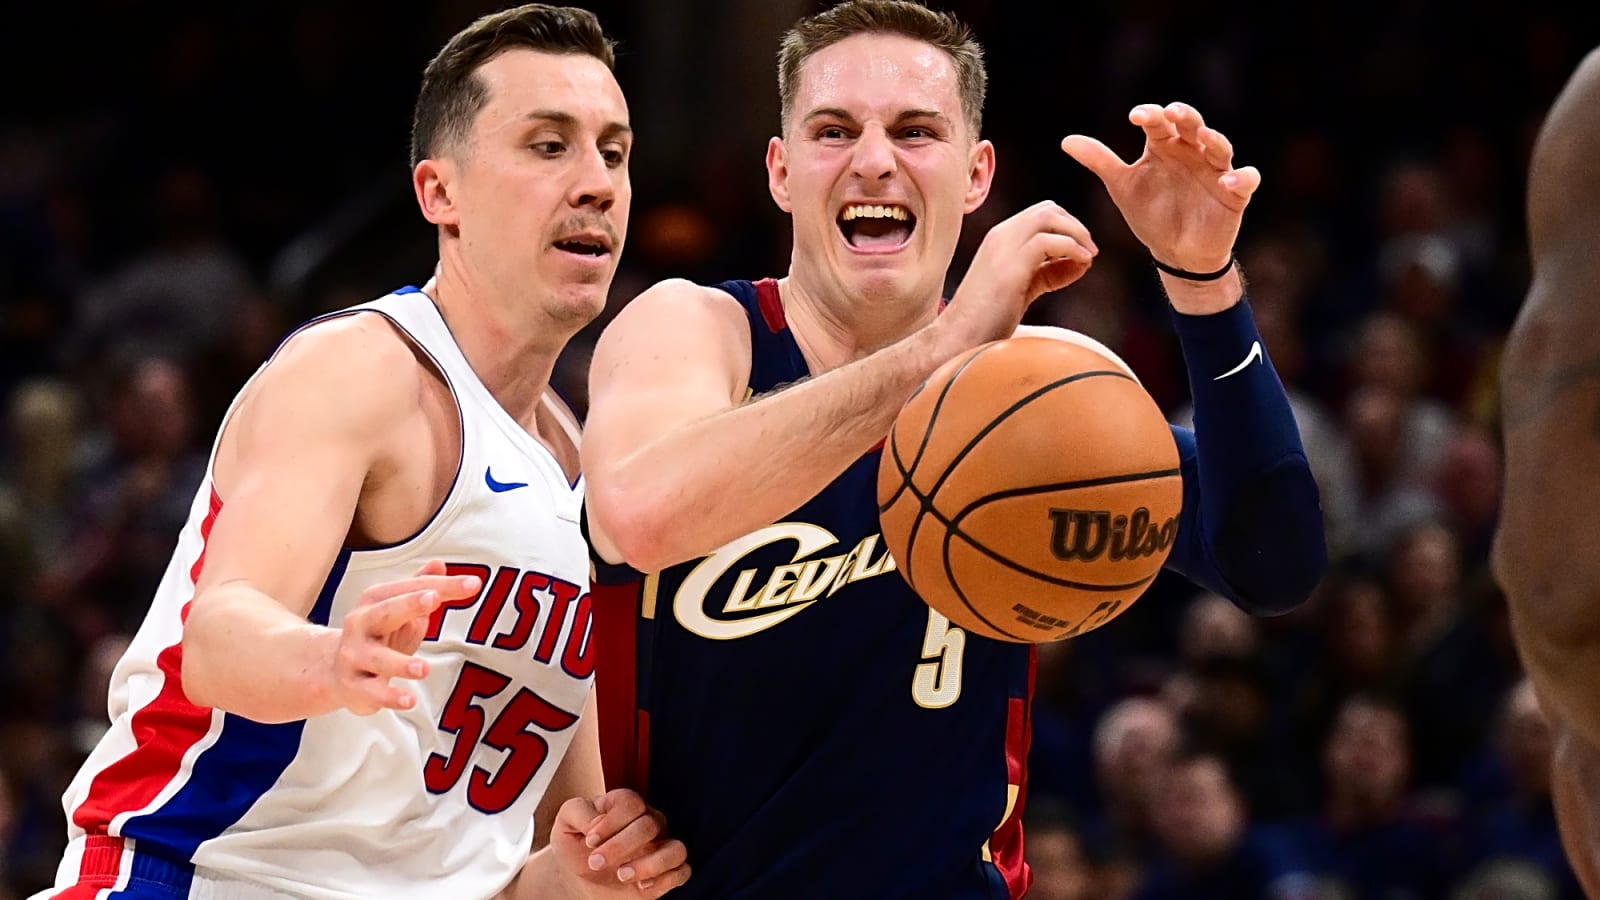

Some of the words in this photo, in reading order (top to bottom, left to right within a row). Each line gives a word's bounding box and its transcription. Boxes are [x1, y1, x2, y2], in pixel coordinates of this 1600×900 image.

[673, 521, 897, 640] CLEVEL
[1048, 506, 1181, 563] Wilso
[911, 607, 966, 709] 5
[423, 660, 581, 815] 55
